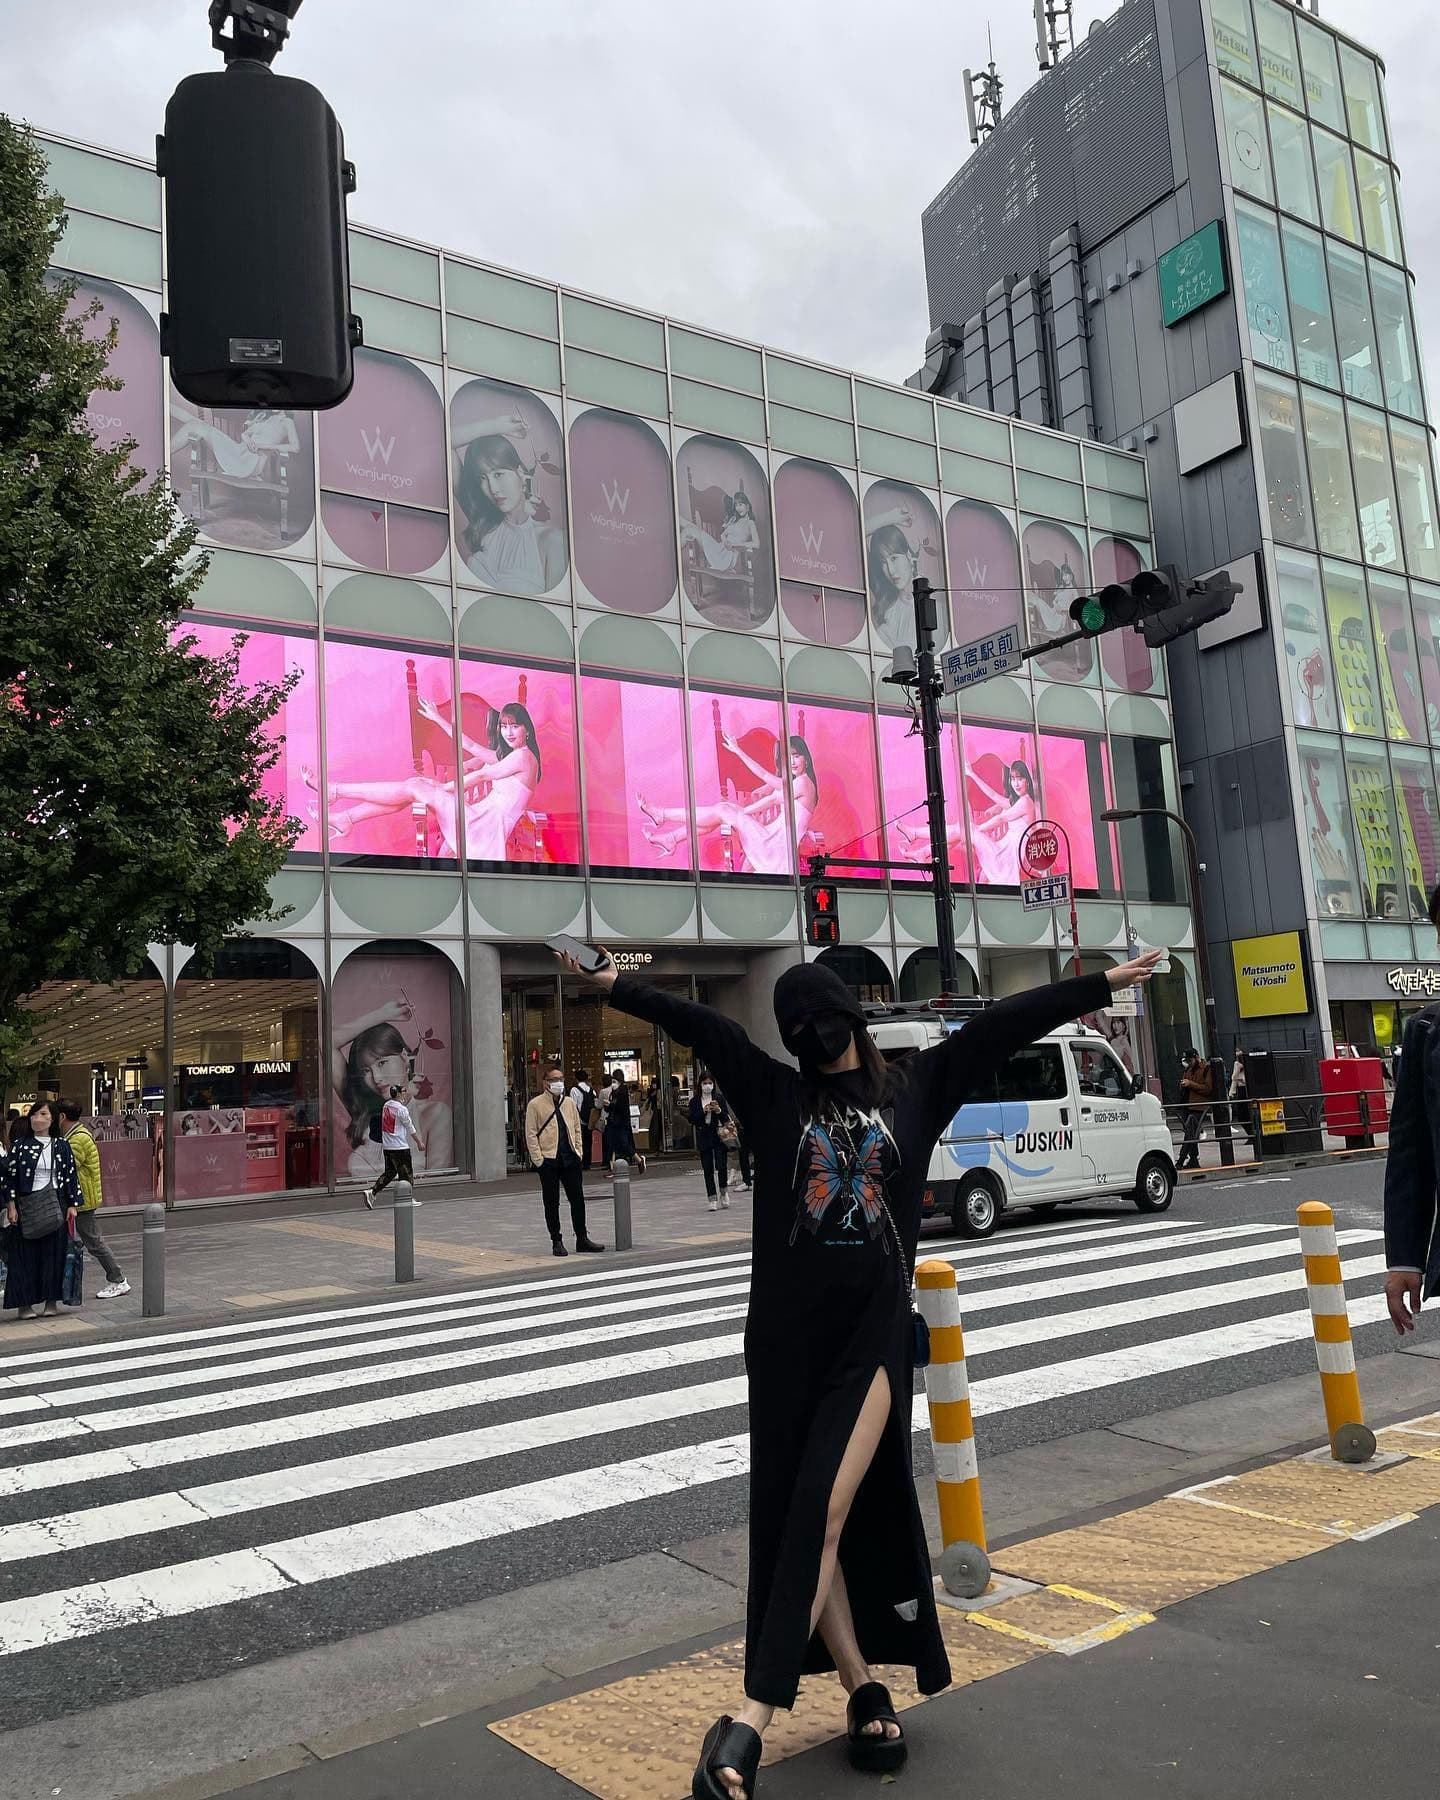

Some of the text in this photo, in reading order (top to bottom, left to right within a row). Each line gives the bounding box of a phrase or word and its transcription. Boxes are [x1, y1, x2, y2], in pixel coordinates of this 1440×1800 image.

[345, 460, 414, 489] Wonjungyo
[589, 512, 646, 536] Wonjungyo
[947, 632, 1014, 675] 原宿駅前
[953, 658, 1011, 687] Harajuku Sta.
[1028, 839, 1057, 861] 消火栓
[1028, 885, 1063, 902] KEN
[609, 952, 653, 963] cosme
[616, 963, 639, 971] TOKYO
[1242, 962, 1296, 977] Matsumoto
[1252, 974, 1287, 987] KiYoshi
[186, 1065, 235, 1076] TOM FORD
[253, 1062, 291, 1074] ARMANI
[1094, 1111, 1130, 1123] 0120-294-394
